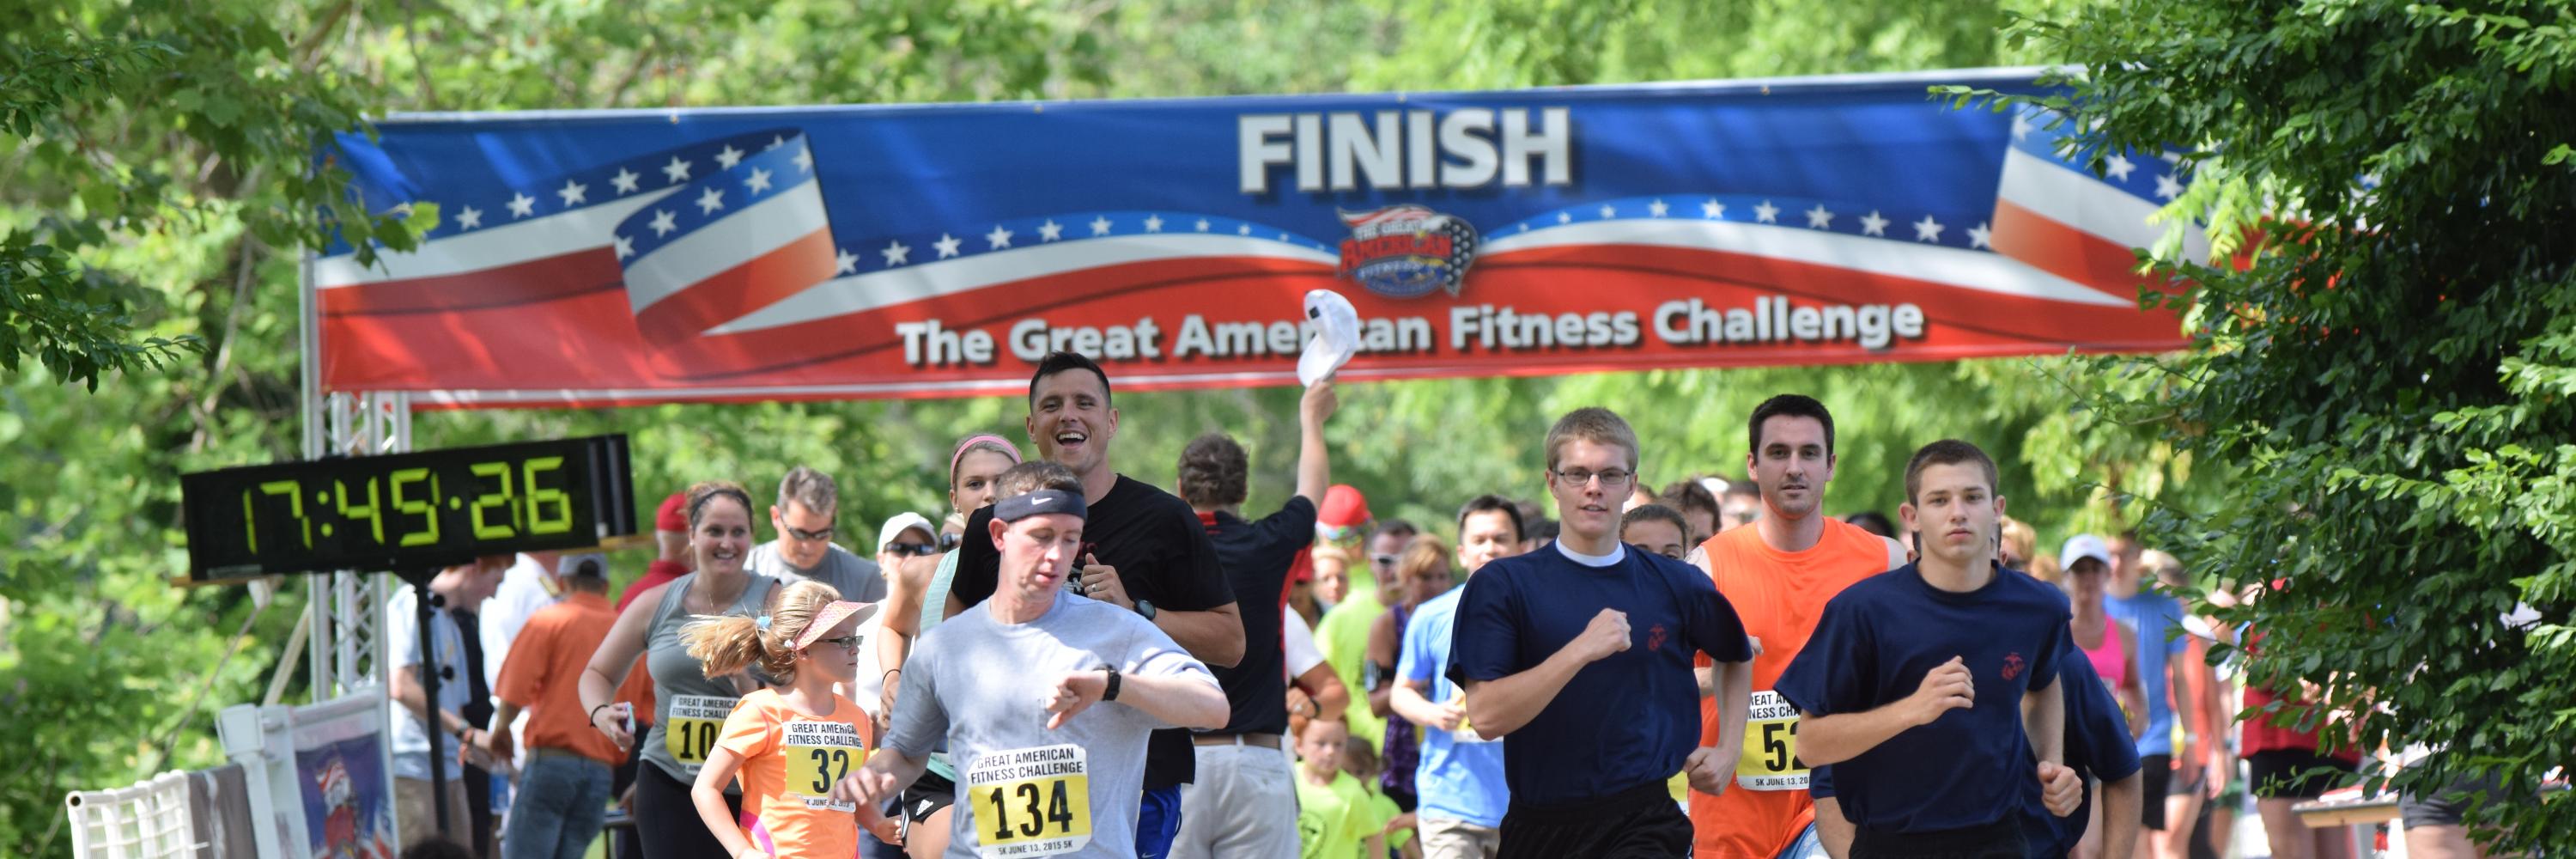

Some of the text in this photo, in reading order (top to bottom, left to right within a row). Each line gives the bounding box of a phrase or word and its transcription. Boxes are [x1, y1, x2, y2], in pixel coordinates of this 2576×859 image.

[1238, 107, 1571, 194] FINISH
[895, 295, 1924, 365] The Great Ameran Fitness Challenge
[678, 697, 738, 709] GREAT AMERIC
[672, 707, 730, 719] FITNESS CHALL
[1748, 707, 1776, 720] NESS
[792, 723, 818, 734] GREAT
[679, 721, 724, 761] 10
[787, 734, 822, 745] FITNESS
[977, 746, 1074, 770] GREAT AMERICAN
[811, 748, 849, 794] 32
[970, 761, 1084, 784] FITNESS CHALLENGE
[1755, 778, 1765, 787] 5K
[1766, 777, 1785, 786] JUNE
[811, 798, 828, 807] JUNE
[989, 779, 1073, 841] 134
[998, 846, 1006, 855] 5K
[1008, 844, 1027, 855] JUNE
[1043, 841, 1062, 851] 2015
[1063, 839, 1073, 849] 5K
